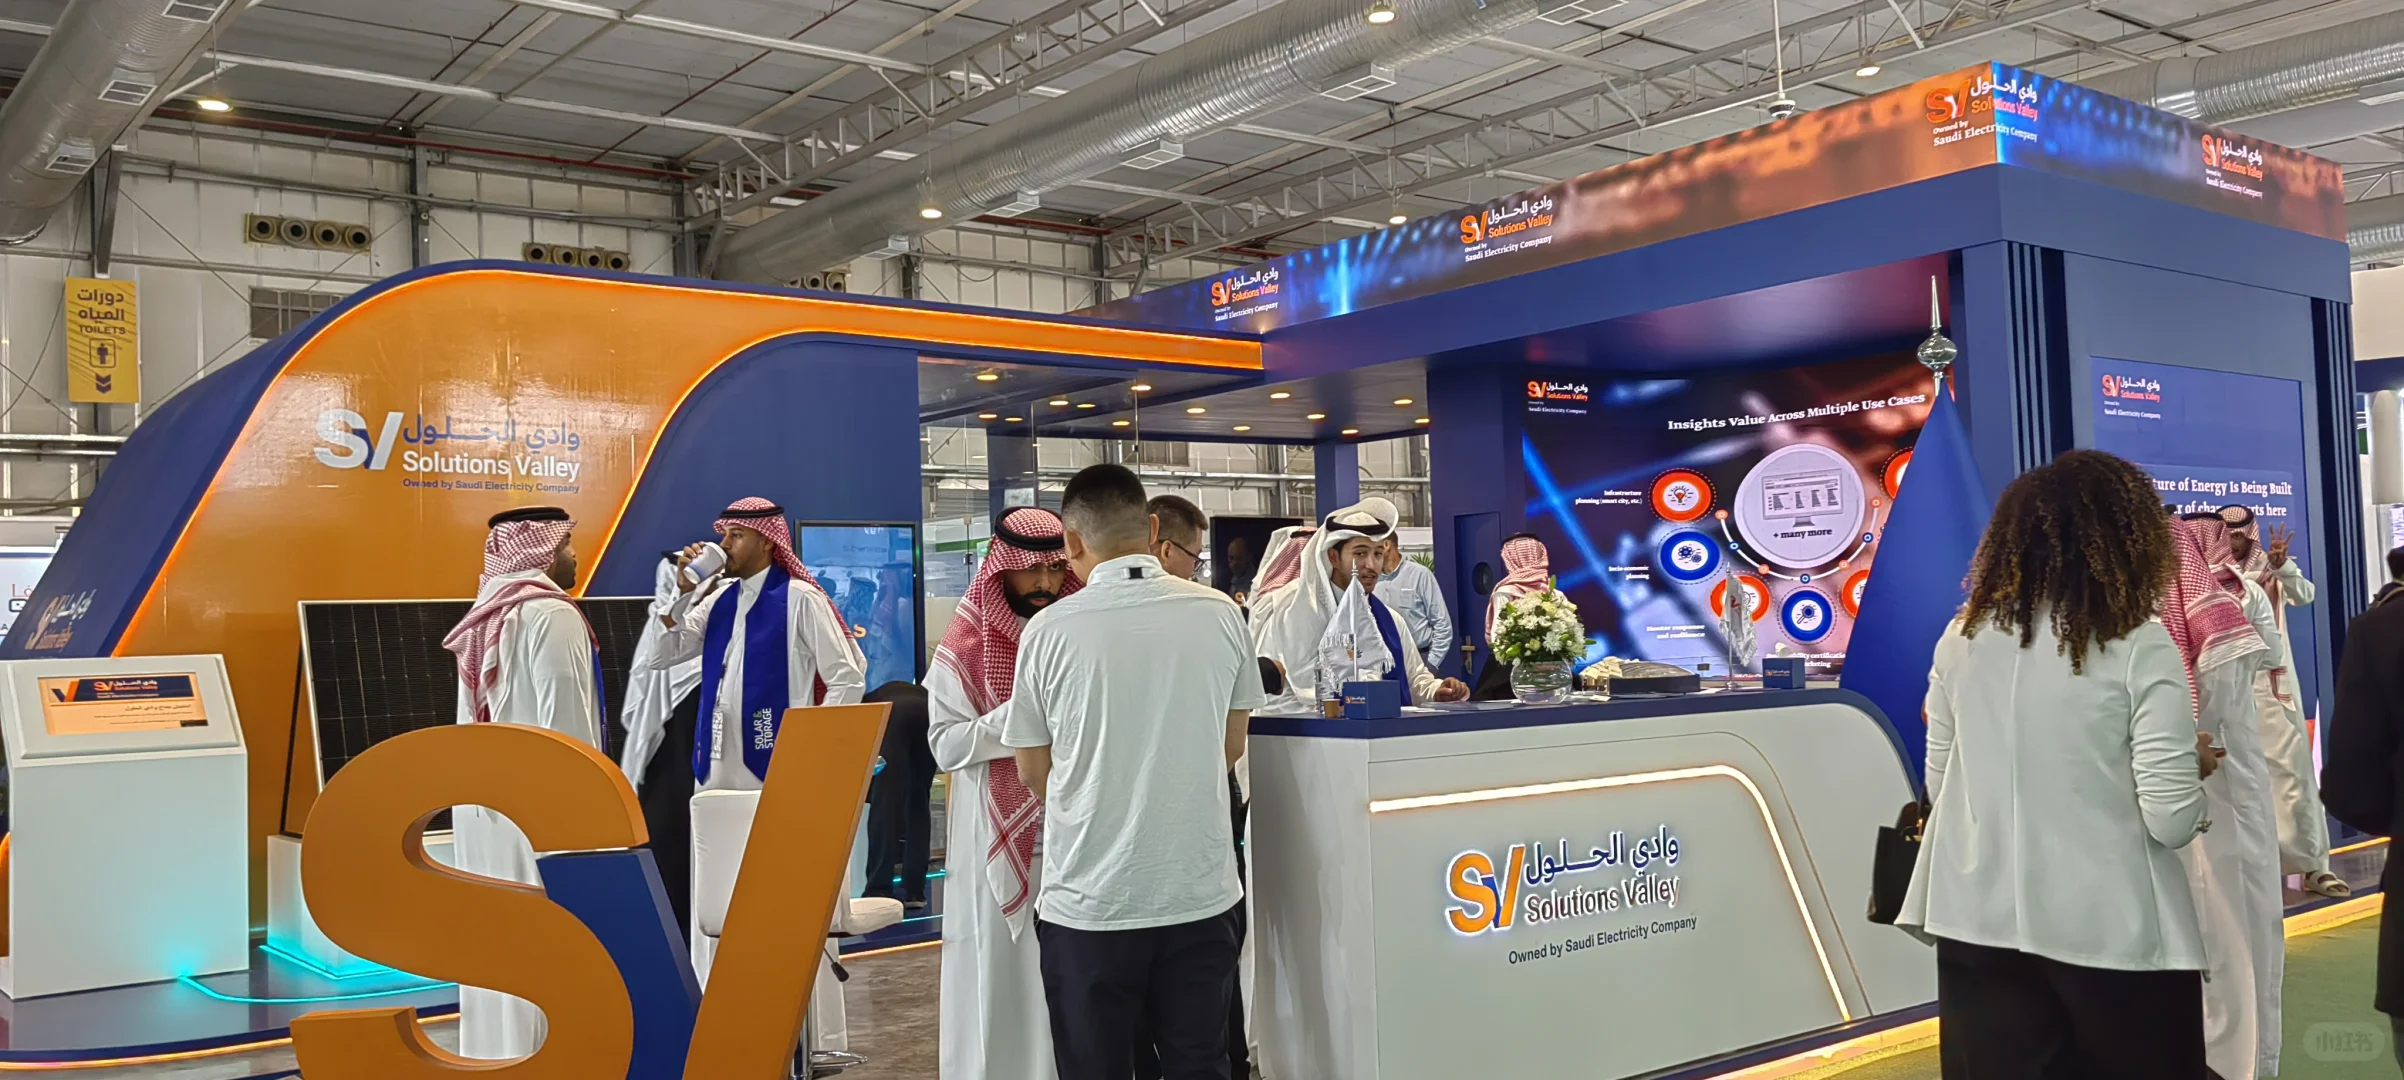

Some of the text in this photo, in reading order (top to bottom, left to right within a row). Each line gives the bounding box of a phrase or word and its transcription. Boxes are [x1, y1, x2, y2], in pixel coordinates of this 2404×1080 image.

[1926, 79, 1971, 123] SV
[1933, 123, 1958, 134] Owned
[1934, 122, 2038, 146] Saudi Electricity Company
[2202, 134, 2222, 167] SV
[1530, 195, 1552, 216] وادي
[1461, 211, 1488, 244] SV
[1489, 214, 1553, 238] Solutions Valley
[1465, 235, 1552, 262] Saudi Electricity Company
[77, 289, 124, 305] دورات
[1212, 278, 1232, 306] SV
[1232, 284, 1278, 302] Solutions Valley
[78, 308, 125, 324] المياه
[80, 325, 126, 334] TOILETS
[1528, 381, 1547, 397] SV
[2102, 374, 2121, 397] SV
[1668, 394, 1926, 431] Insights Value Across Multiple Use Cases
[313, 408, 404, 470] SV
[403, 414, 580, 454] وادي الحلول
[402, 450, 580, 482] Solutions Valley
[403, 478, 438, 488] Owned
[456, 480, 482, 490] Saudi
[486, 481, 534, 492] Electricity
[536, 483, 580, 494] Company
[2152, 477, 2292, 497] ture of Energy Is Being Built
[2185, 501, 2196, 514] of
[2266, 503, 2286, 516] here
[1780, 530, 1806, 539] many
[754, 720, 764, 750] SOLAR
[762, 708, 774, 749] STORAGE
[1526, 825, 1679, 885] وادي الحلول
[290, 702, 893, 1079] SV
[1448, 845, 1526, 933] SV
[1526, 874, 1680, 923] Solutions Valley
[1508, 945, 1547, 964] Owned
[1565, 934, 1594, 952] Saudi
[1597, 925, 1649, 946] Electricity
[1651, 916, 1697, 934] Company
